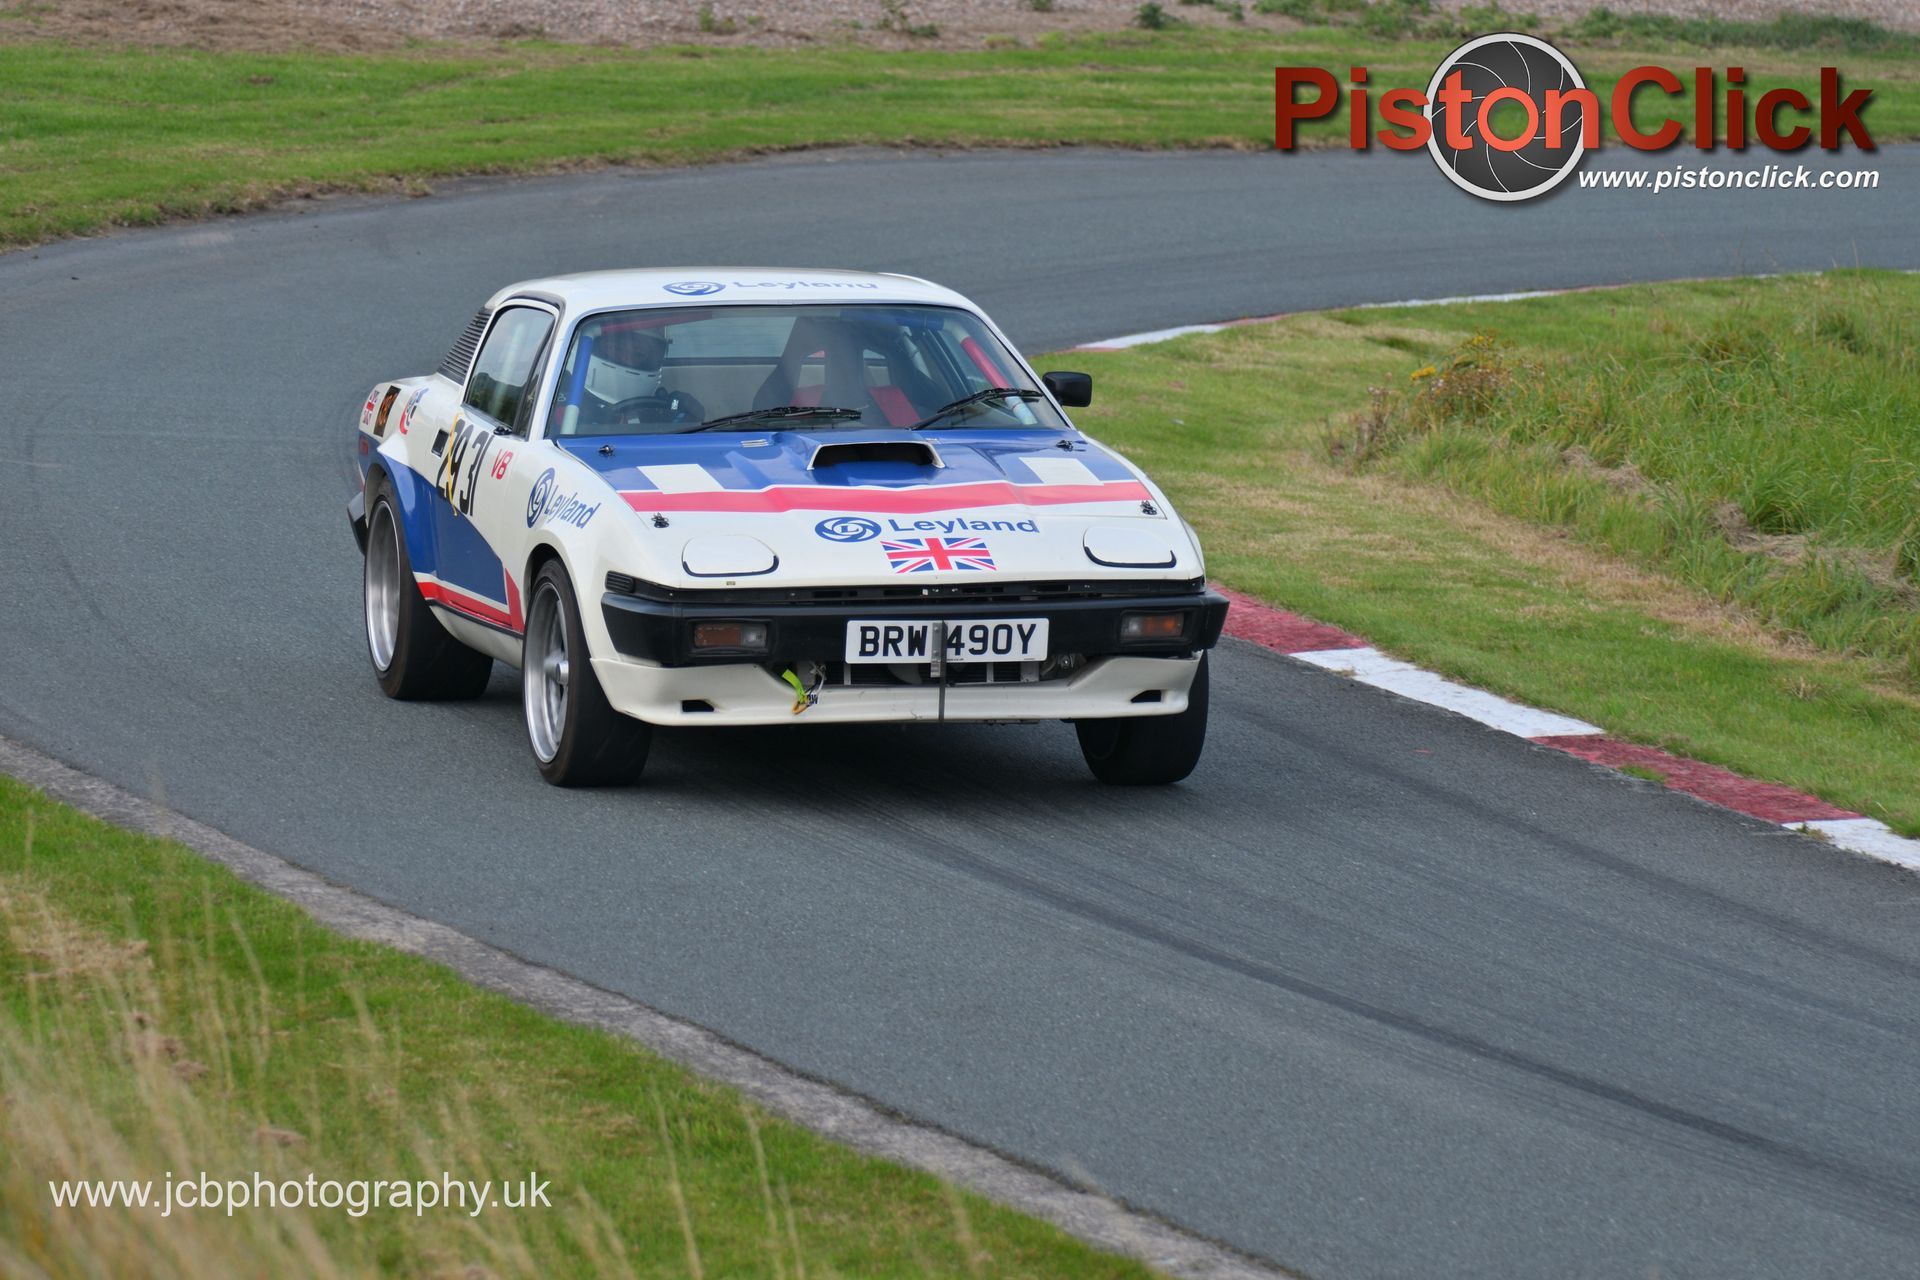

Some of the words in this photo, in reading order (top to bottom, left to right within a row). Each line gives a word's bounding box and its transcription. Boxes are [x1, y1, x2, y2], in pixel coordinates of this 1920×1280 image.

[491, 449, 514, 480] V8
[544, 484, 602, 529] Leyland
[888, 517, 1040, 533] Leyland
[859, 625, 928, 657] BRW
[946, 624, 1037, 656] 490Y
